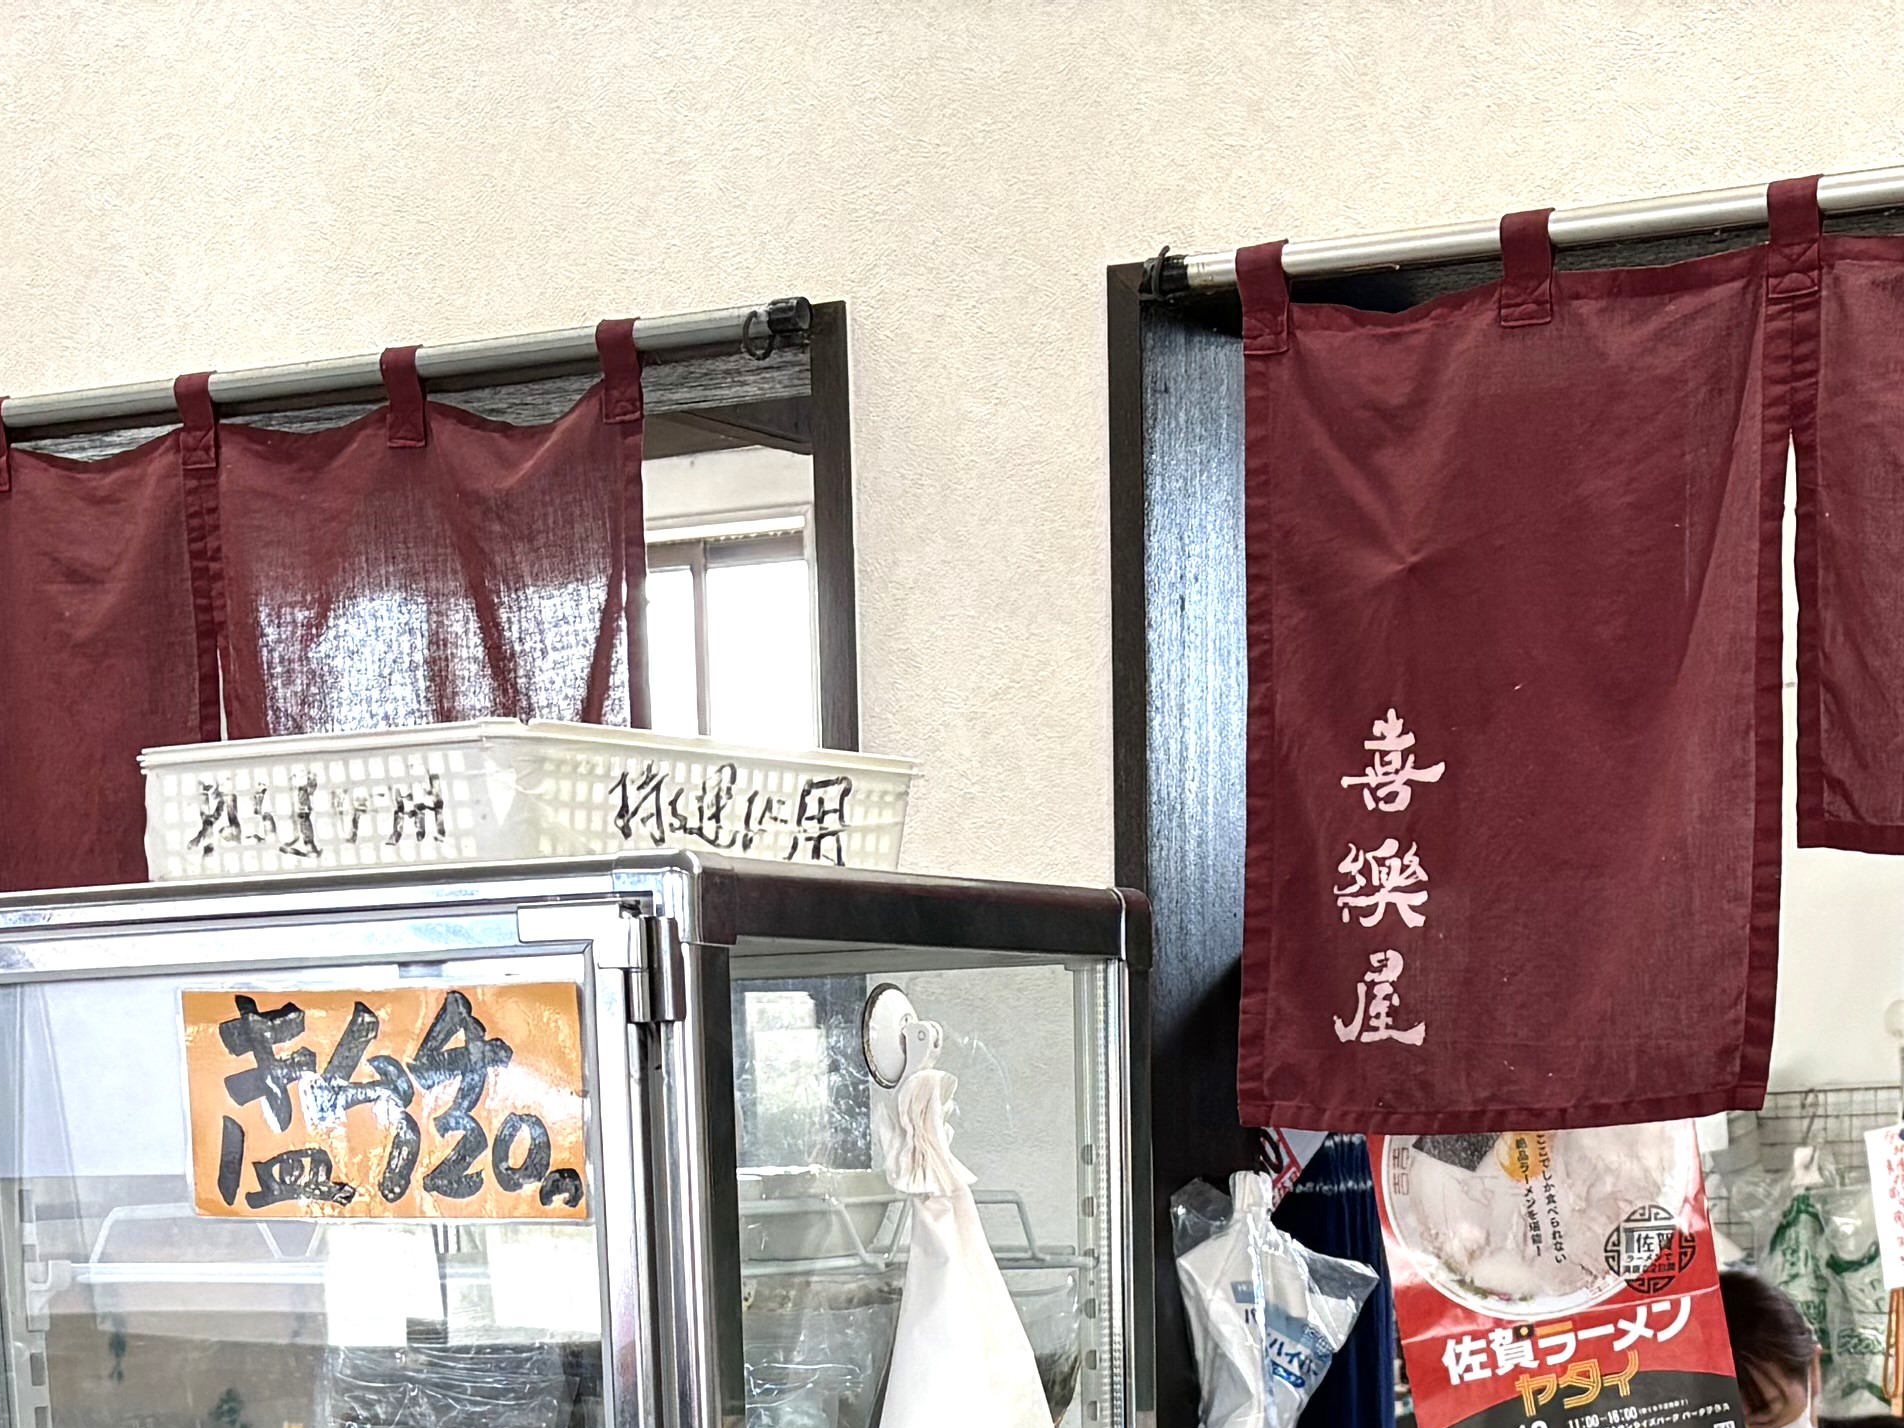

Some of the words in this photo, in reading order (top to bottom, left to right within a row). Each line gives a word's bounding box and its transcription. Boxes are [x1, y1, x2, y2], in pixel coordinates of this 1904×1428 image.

[1442, 1295, 1693, 1387] 佐賀ラーメン
